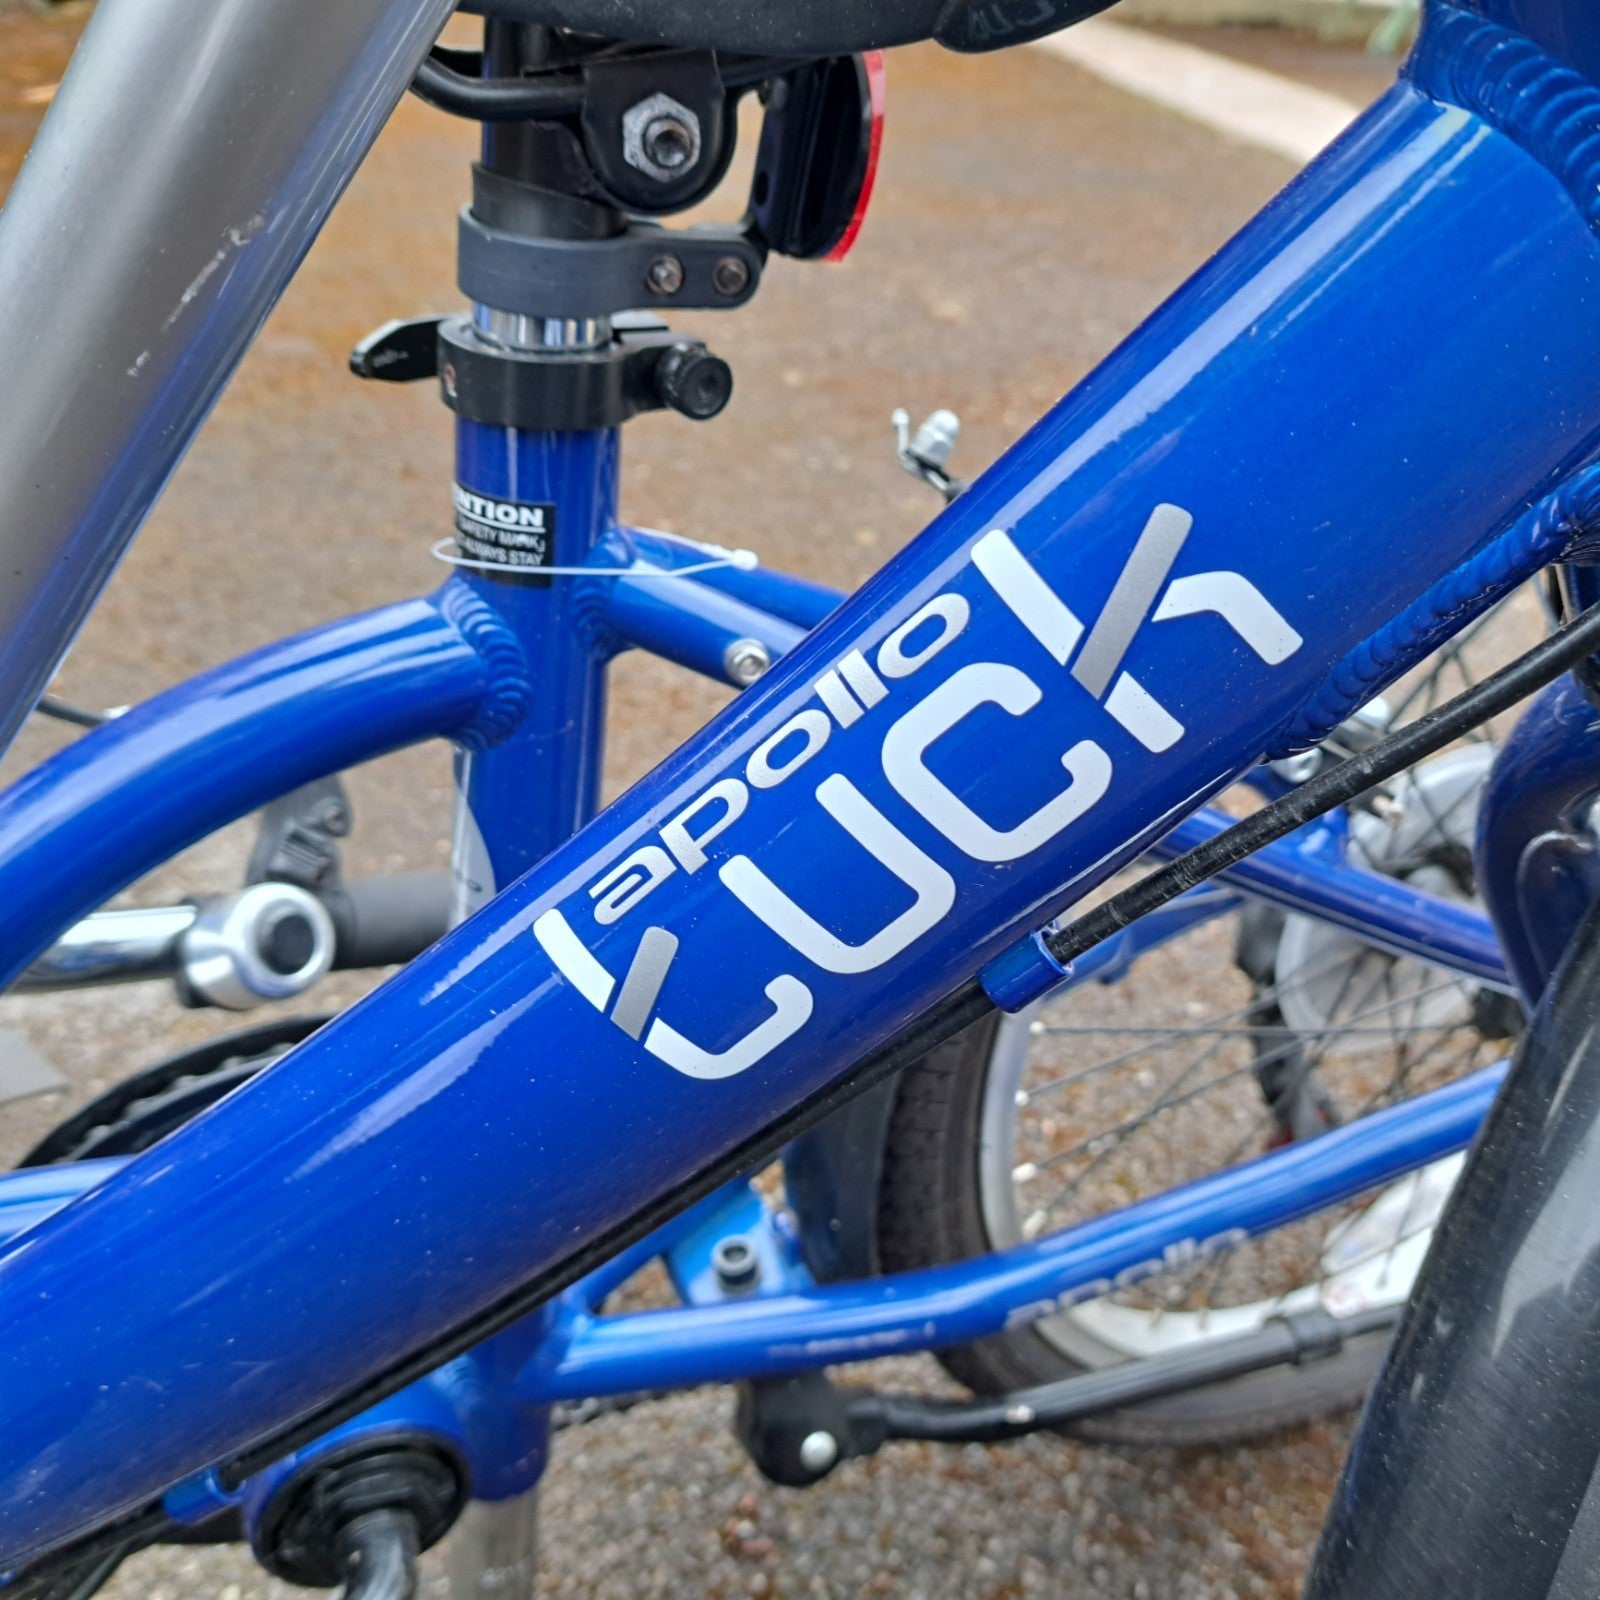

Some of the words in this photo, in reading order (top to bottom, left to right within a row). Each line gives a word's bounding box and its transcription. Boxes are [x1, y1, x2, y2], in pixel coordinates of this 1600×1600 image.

[455, 486, 543, 527] NTION
[508, 550, 543, 566] STAY
[588, 592, 970, 925] apollo
